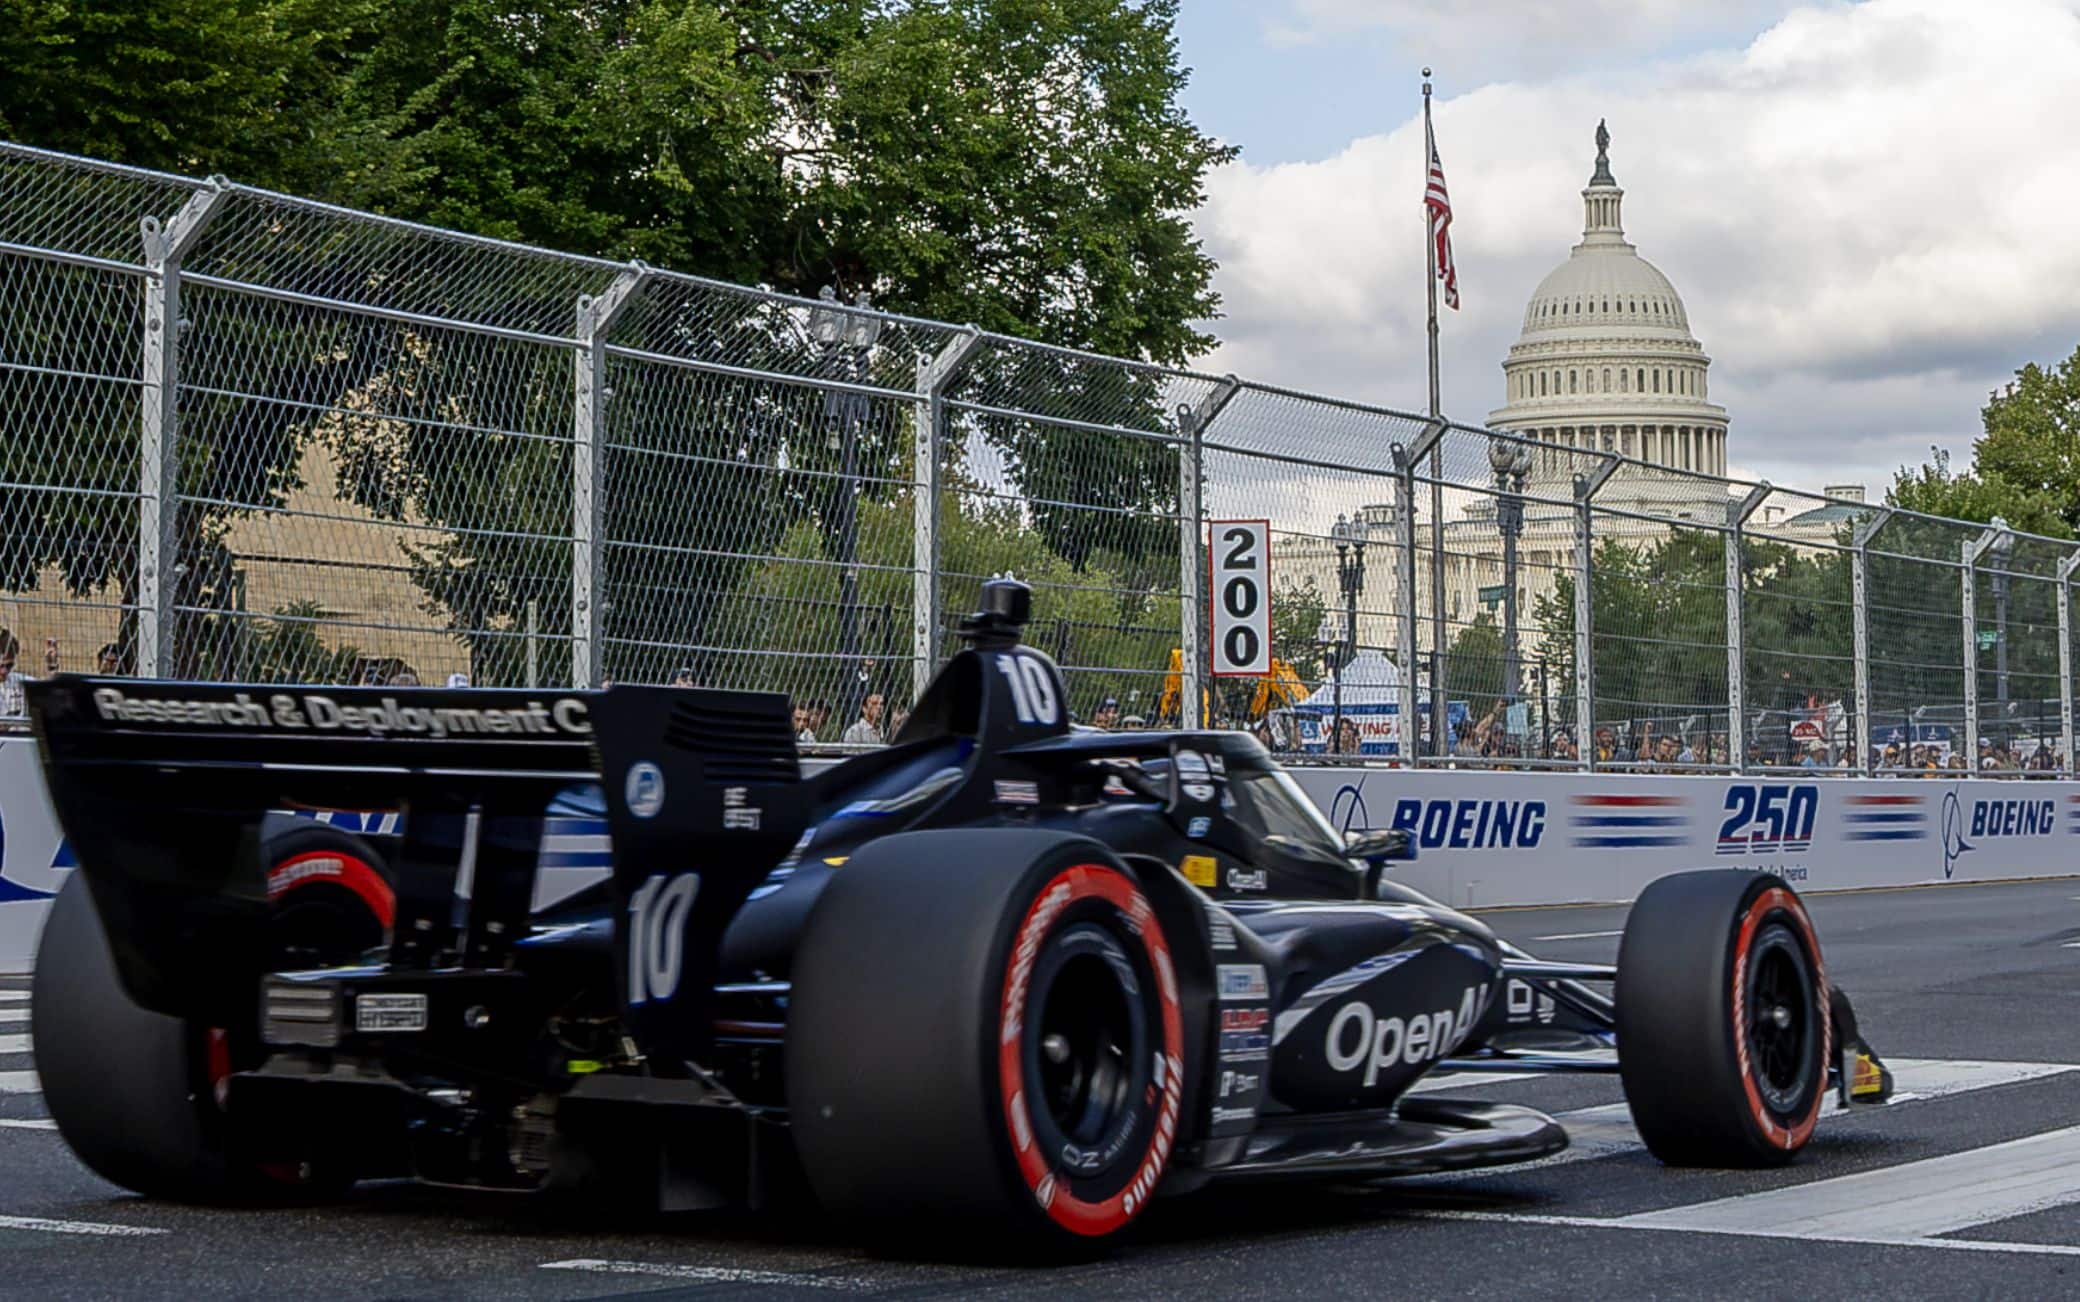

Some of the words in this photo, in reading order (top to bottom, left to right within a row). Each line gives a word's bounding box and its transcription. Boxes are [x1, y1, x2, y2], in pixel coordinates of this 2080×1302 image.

[1223, 527, 1259, 667] 200
[93, 688, 273, 727] Research
[270, 694, 309, 728] &
[303, 695, 557, 738] Deployment
[996, 654, 1057, 724] 10
[1321, 722, 1392, 736] WTING
[1391, 799, 1545, 848] BOEING
[1715, 785, 1818, 854] 250
[1970, 800, 2055, 836] BOEING
[628, 872, 700, 1004] 10
